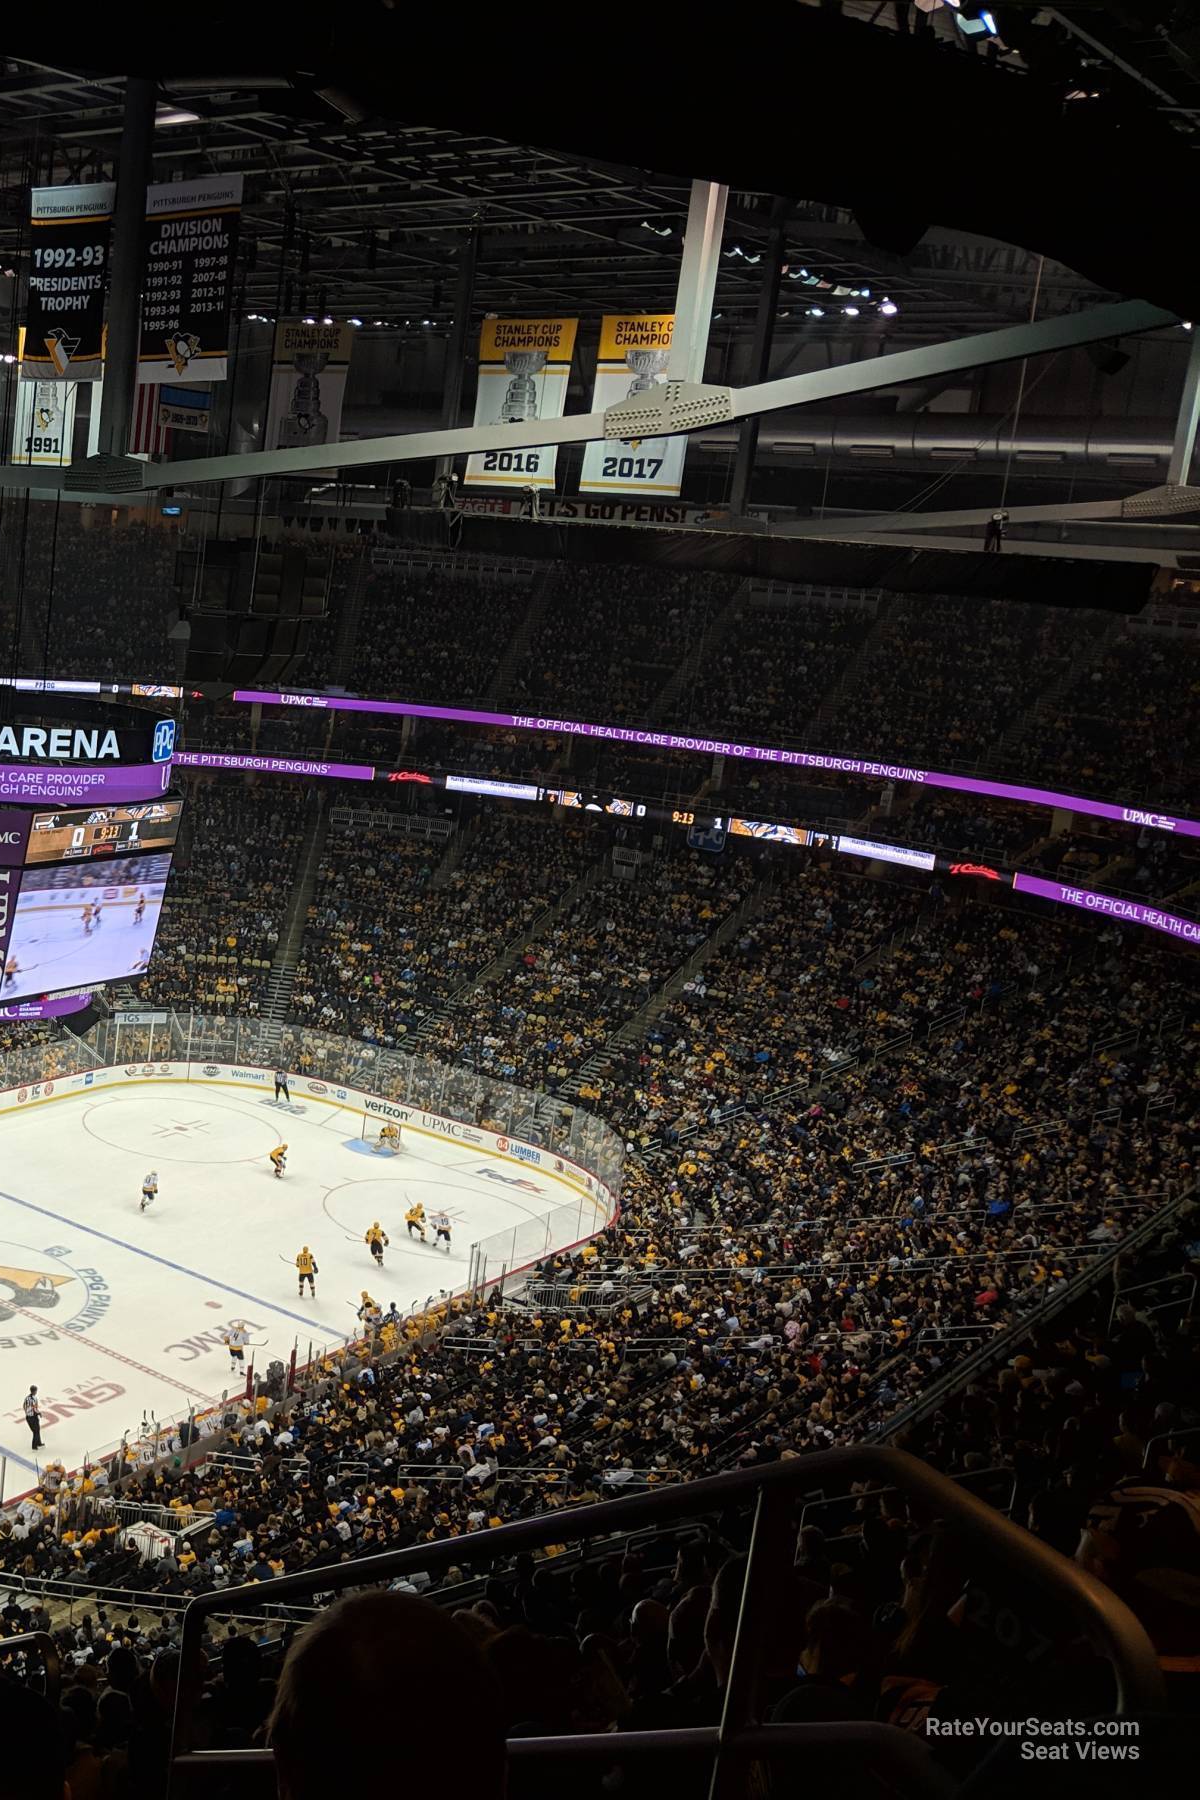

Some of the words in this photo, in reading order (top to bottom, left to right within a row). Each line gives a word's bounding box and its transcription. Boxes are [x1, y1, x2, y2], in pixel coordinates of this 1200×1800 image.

[152, 195, 193, 207] PITTSBURGH
[194, 190, 234, 201] PENGUINS
[36, 204, 74, 214] PITTSBURGH
[76, 203, 107, 211] PENGUINS
[161, 218, 222, 237] DIVISION
[150, 233, 229, 255] CHAMPIONS
[34, 245, 104, 268] 1992-93
[147, 260, 182, 272] 1990-91
[30, 274, 101, 292] PRESIDENTS
[146, 274, 182, 286] 1991-92
[40, 295, 90, 311] TROPHY
[146, 290, 181, 301] 1992-93
[144, 304, 180, 316] 1993-94
[144, 319, 179, 331] 1995-96
[285, 328, 320, 338] STANLEY
[323, 328, 342, 338] CUP
[496, 324, 541, 335] STANLEY
[542, 324, 563, 335] CUP
[616, 321, 661, 333] STANLEY
[285, 339, 339, 349] CHAMPIONS
[494, 336, 561, 348] CHAMPIONS
[615, 333, 672, 346] CHAMPIO
[25, 437, 60, 454] 1991
[483, 452, 540, 473] 2016
[602, 457, 664, 479] 2017
[585, 502, 617, 520] GO
[620, 503, 687, 524] PENS!
[281, 695, 312, 706] UPMC
[154, 724, 174, 757] PPG
[512, 716, 533, 728] THE
[537, 718, 588, 734] OFFICIAL
[590, 726, 634, 741] HEALTH
[636, 732, 667, 745] CARE
[670, 737, 730, 755] PROVIDER
[733, 745, 751, 756] OF
[754, 748, 778, 761] THE
[781, 752, 861, 772] PITTSBURGH
[178, 753, 198, 764] THE
[201, 755, 269, 769] PITTSBURGH
[8, 771, 44, 784] CARE
[46, 774, 105, 785] PROVIDER
[636, 804, 646, 816] 0
[672, 811, 694, 824] 9:13
[1123, 808, 1159, 827] UPMC
[129, 821, 139, 841] 1
[713, 817, 723, 829] 1
[71, 827, 85, 847] 0
[100, 825, 119, 840] 9:13
[1061, 887, 1083, 904] THE
[1086, 894, 1141, 921] OFFICIAL
[1143, 911, 1182, 934] HEALTH
[123, 1014, 140, 1023] IGS
[231, 1069, 265, 1081] Walmart
[364, 1098, 409, 1121] verizon
[422, 1115, 462, 1137] UPMC
[510, 1143, 541, 1160] LUMBER
[300, 1256, 308, 1267] 10
[78, 1268, 108, 1291] PPG
[65, 1290, 111, 1333] PAINTS
[62, 1376, 108, 1395] LIVE
[13, 1383, 126, 1429] GNC
